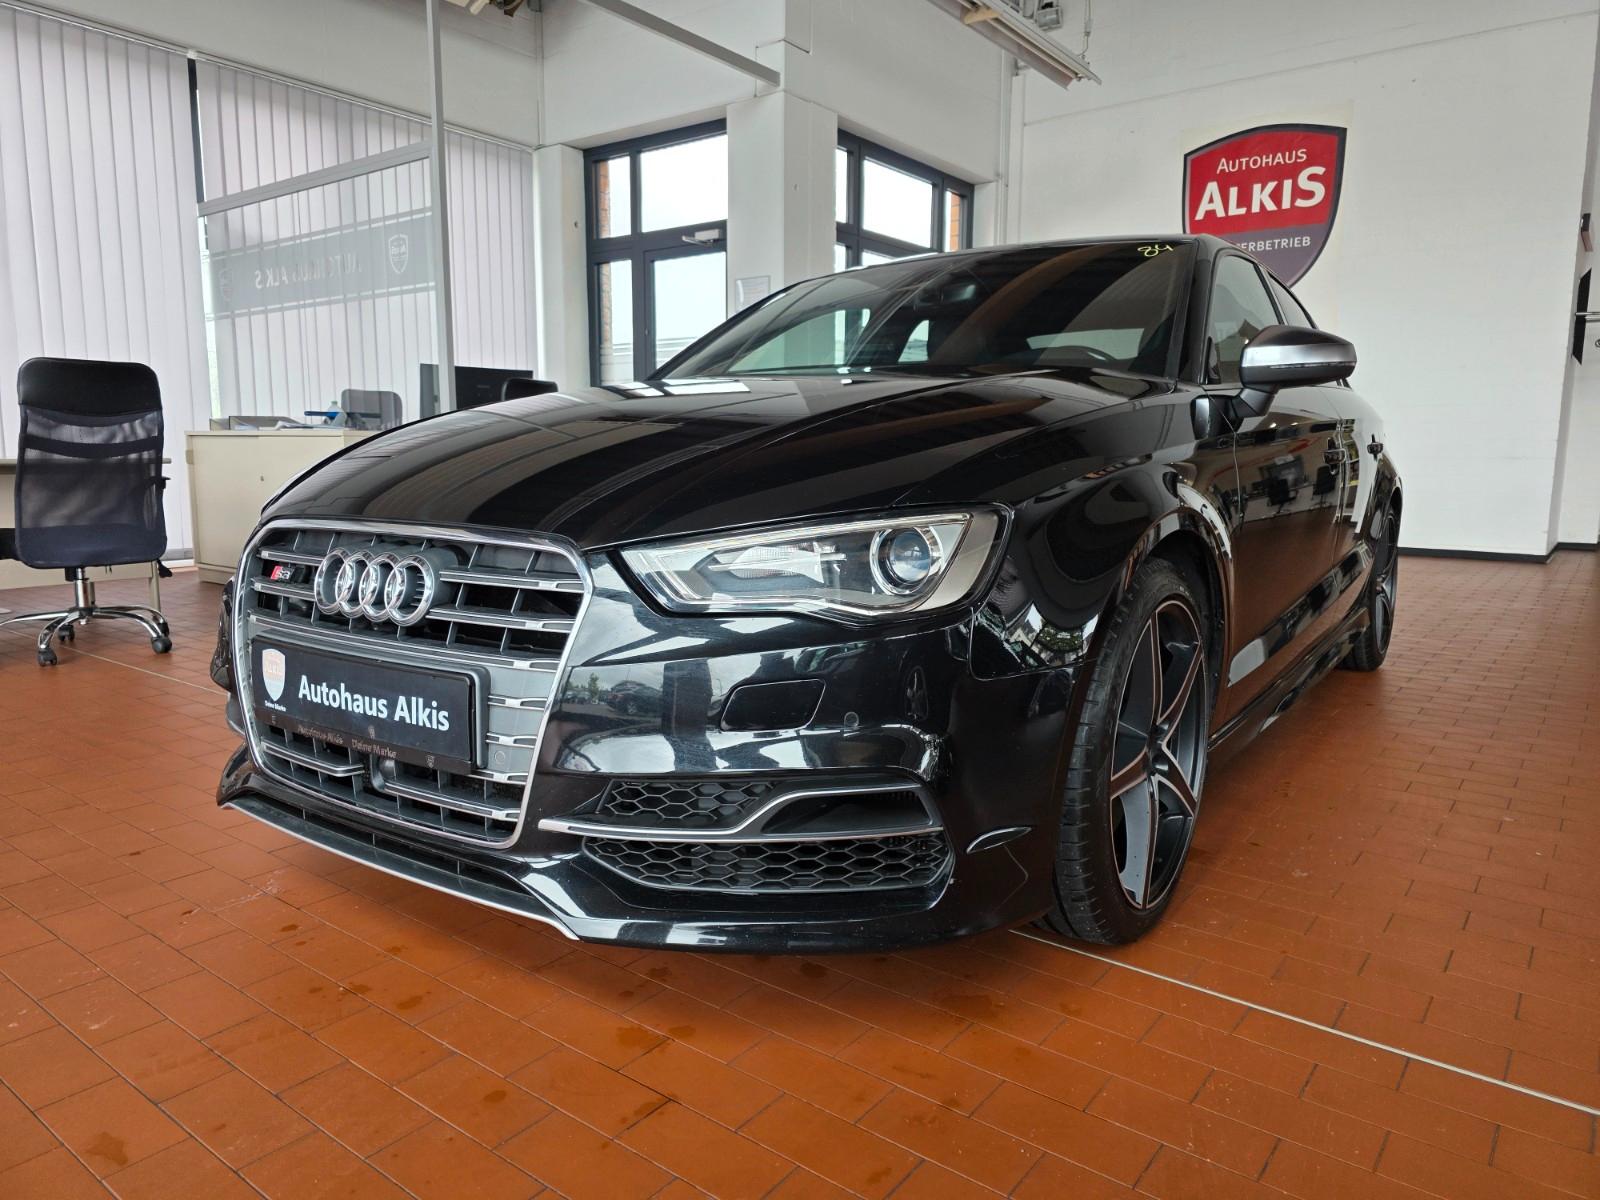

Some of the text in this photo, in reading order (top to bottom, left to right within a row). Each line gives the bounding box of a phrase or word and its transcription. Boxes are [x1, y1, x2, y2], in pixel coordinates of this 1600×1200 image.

[1216, 149, 1307, 174] AUTOHAUS
[1195, 166, 1326, 220] ALKIS
[1237, 236, 1311, 251] ERBETRIEB
[298, 675, 450, 731] Autohaus Alkis
